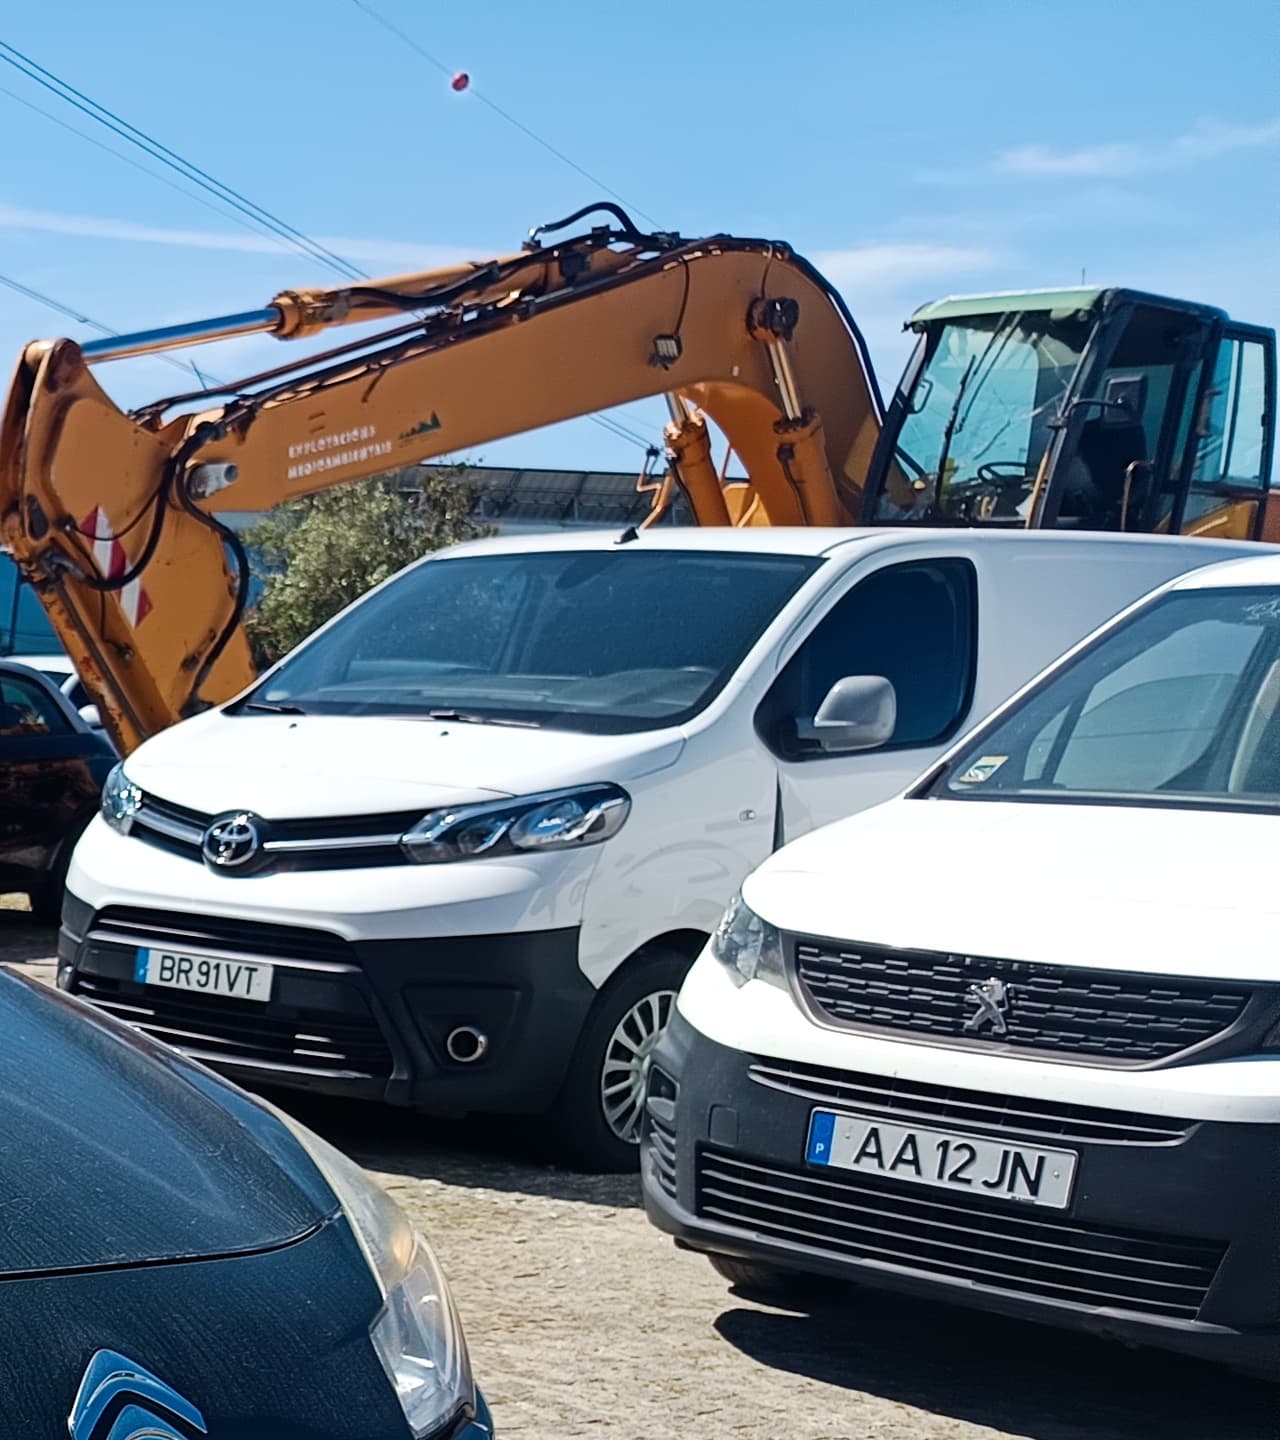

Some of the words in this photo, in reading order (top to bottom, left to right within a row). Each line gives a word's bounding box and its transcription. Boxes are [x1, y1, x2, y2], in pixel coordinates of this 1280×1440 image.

[159, 955, 259, 996] BR91VT
[814, 1142, 825, 1154] P
[852, 1126, 1047, 1198] AA12JN
